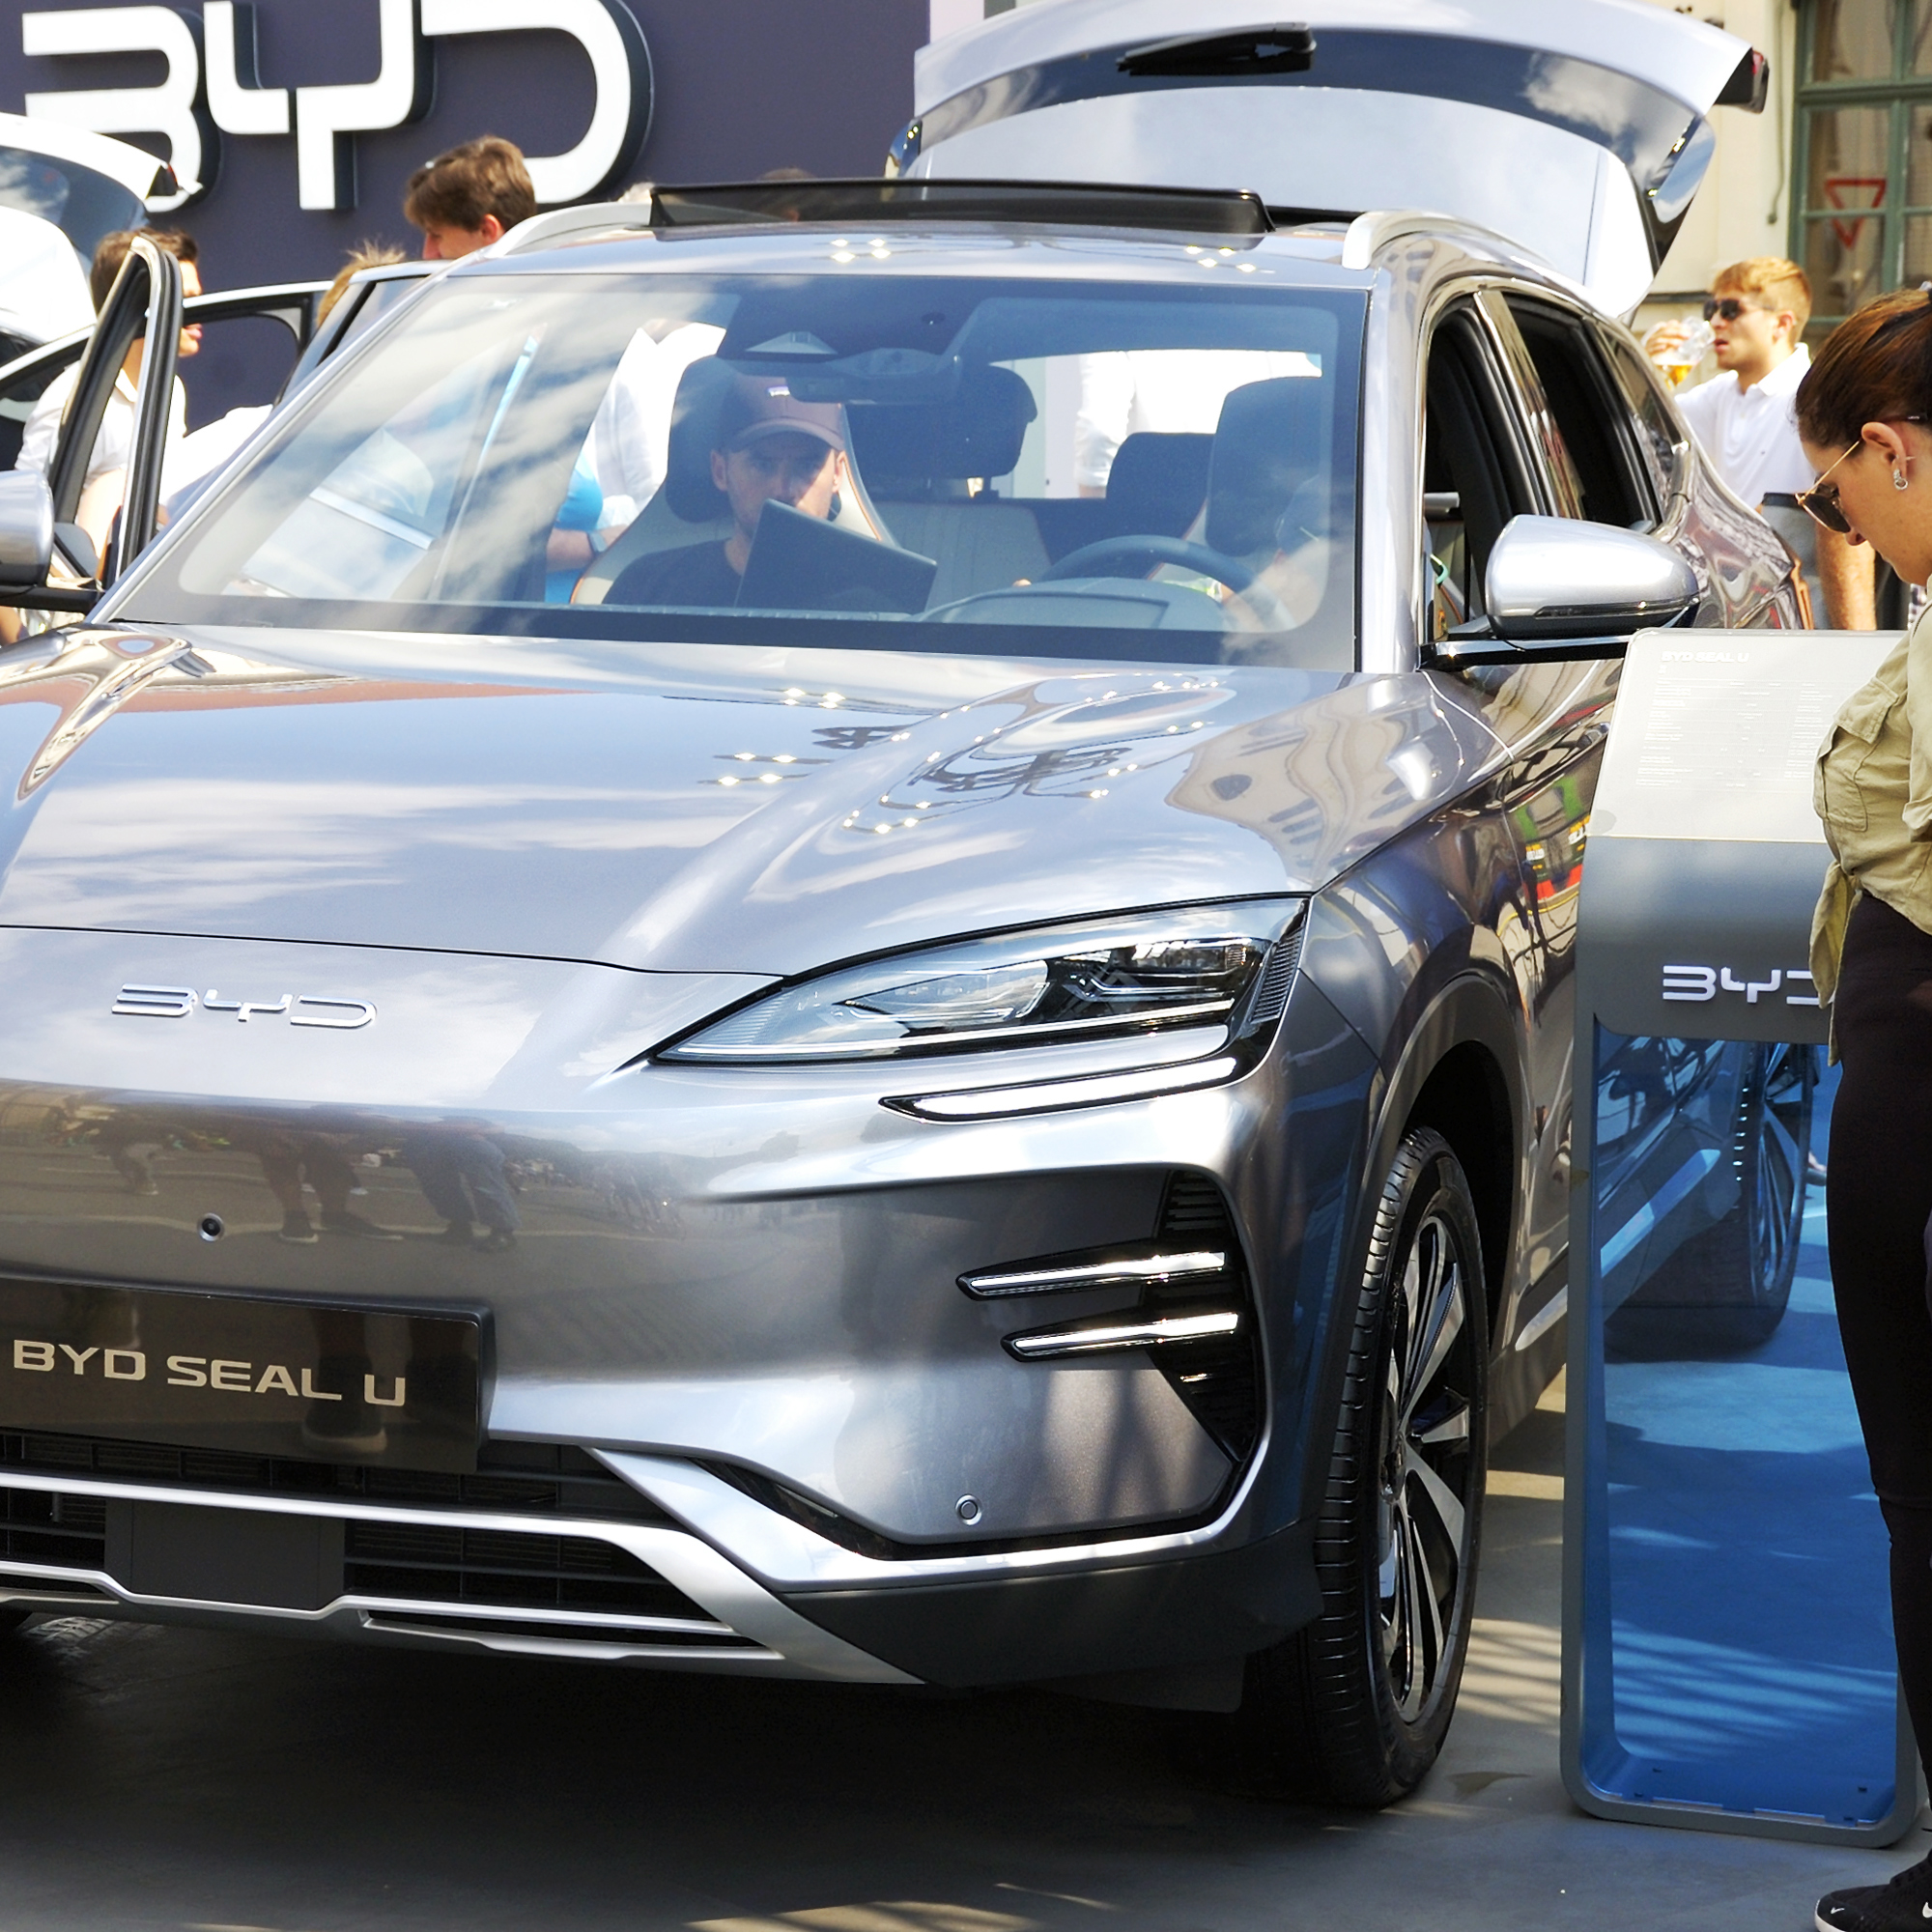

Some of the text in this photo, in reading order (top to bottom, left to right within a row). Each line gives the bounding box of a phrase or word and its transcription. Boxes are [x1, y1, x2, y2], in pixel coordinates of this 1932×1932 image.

[22, 0, 631, 213] BYD
[1662, 651, 1749, 664] BYD SEAL U
[112, 983, 377, 1029] BYD
[14, 1339, 406, 1406] BYD SEAL U
